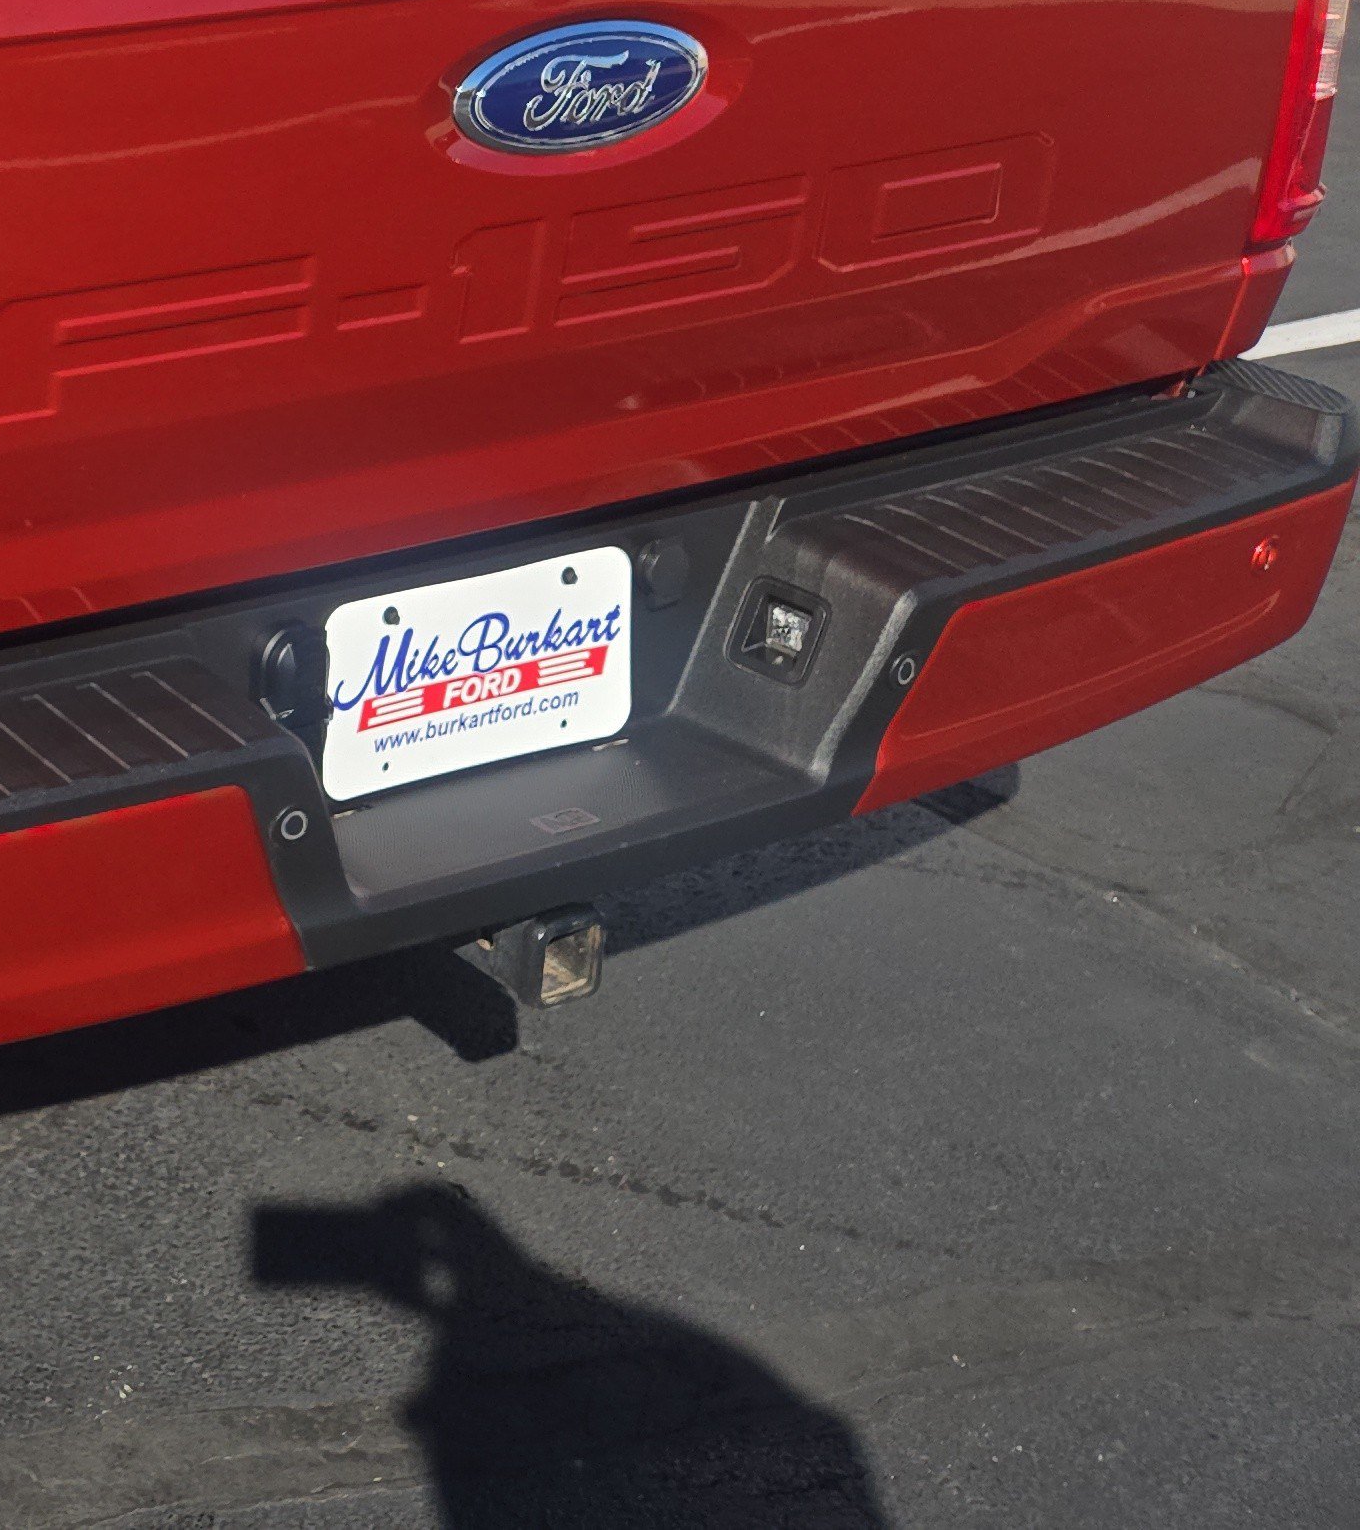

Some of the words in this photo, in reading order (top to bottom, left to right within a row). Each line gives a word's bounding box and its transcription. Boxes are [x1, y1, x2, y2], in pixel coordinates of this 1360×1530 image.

[523, 50, 662, 131] Ford
[333, 628, 460, 711] Mike
[458, 604, 621, 673] Burkart
[442, 669, 522, 709] FORD
[374, 690, 580, 753] www.burkartford.com
